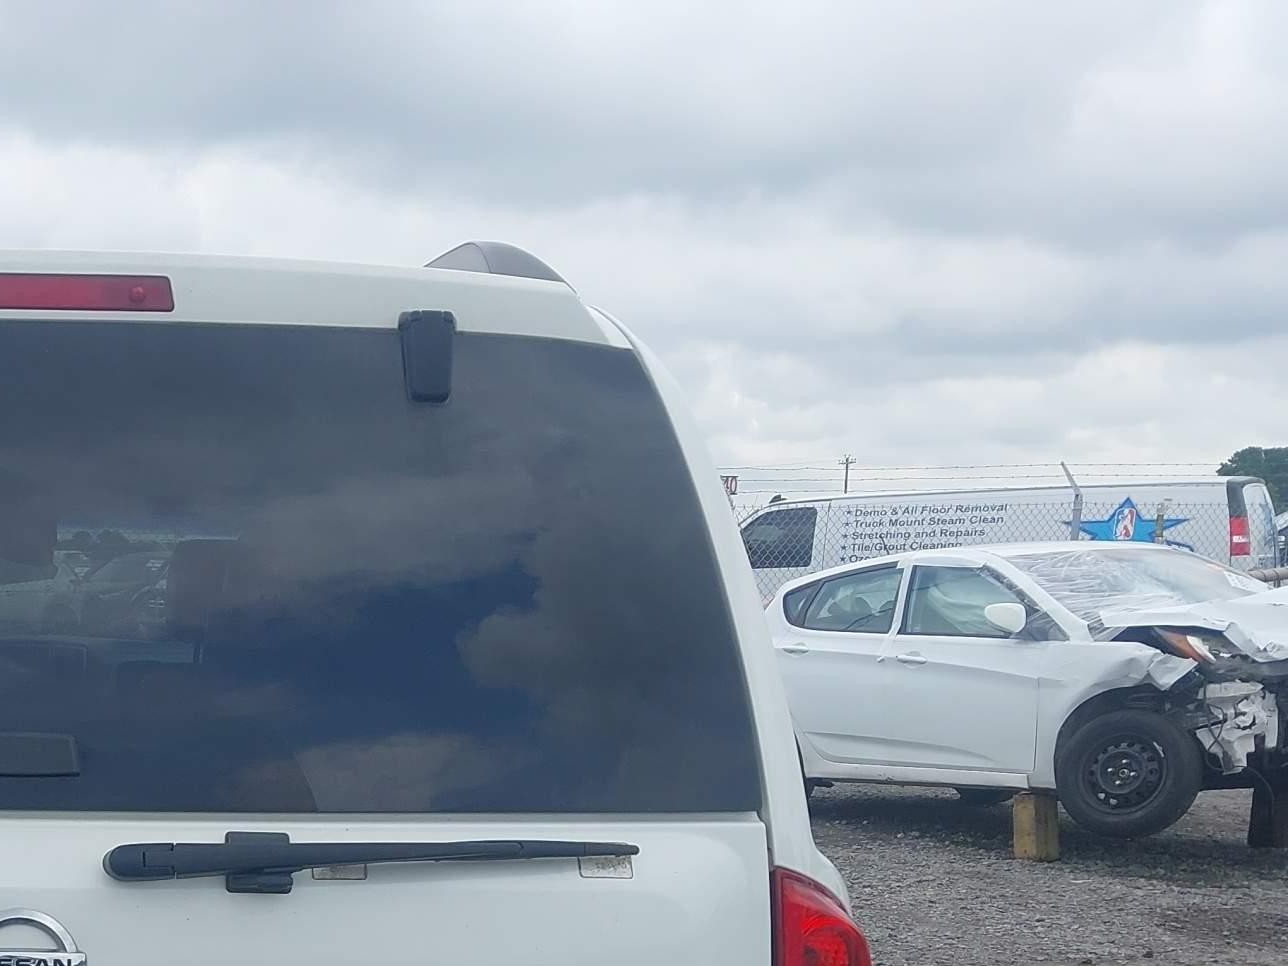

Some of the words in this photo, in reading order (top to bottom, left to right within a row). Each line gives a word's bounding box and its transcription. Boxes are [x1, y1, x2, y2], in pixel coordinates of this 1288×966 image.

[854, 508, 887, 517] Demo
[890, 506, 899, 516] &
[902, 505, 918, 515] All
[920, 505, 953, 515] Floor
[955, 503, 1009, 513] Removal
[854, 519, 884, 528] Truck
[888, 518, 926, 527] Mount
[928, 516, 966, 526] Steam
[969, 515, 1005, 525] Clean
[851, 530, 911, 541] Stretching
[914, 529, 937, 539] and
[939, 527, 986, 539] Repairs
